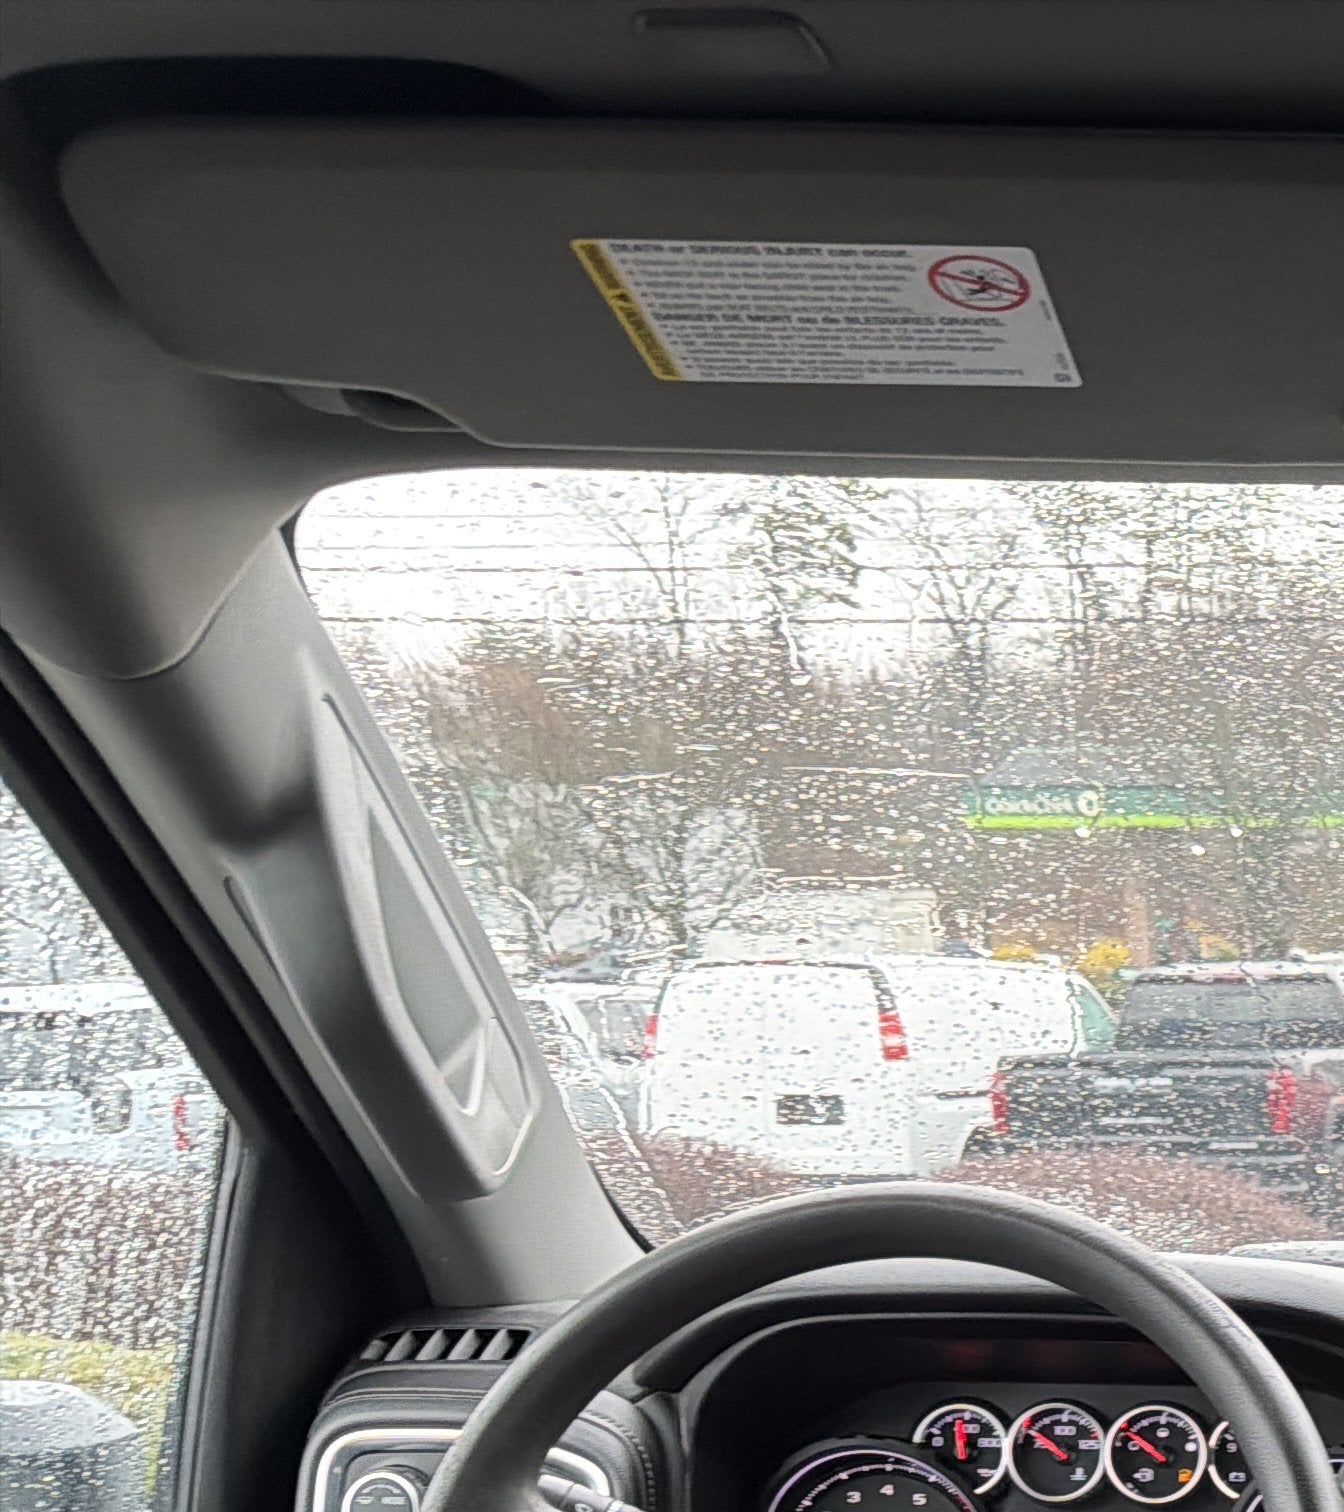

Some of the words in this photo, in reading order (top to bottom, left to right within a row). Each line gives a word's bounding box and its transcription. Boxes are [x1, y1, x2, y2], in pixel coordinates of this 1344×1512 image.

[879, 1484, 895, 1496] 4
[846, 1491, 862, 1503] 3
[911, 1493, 927, 1506] 5
